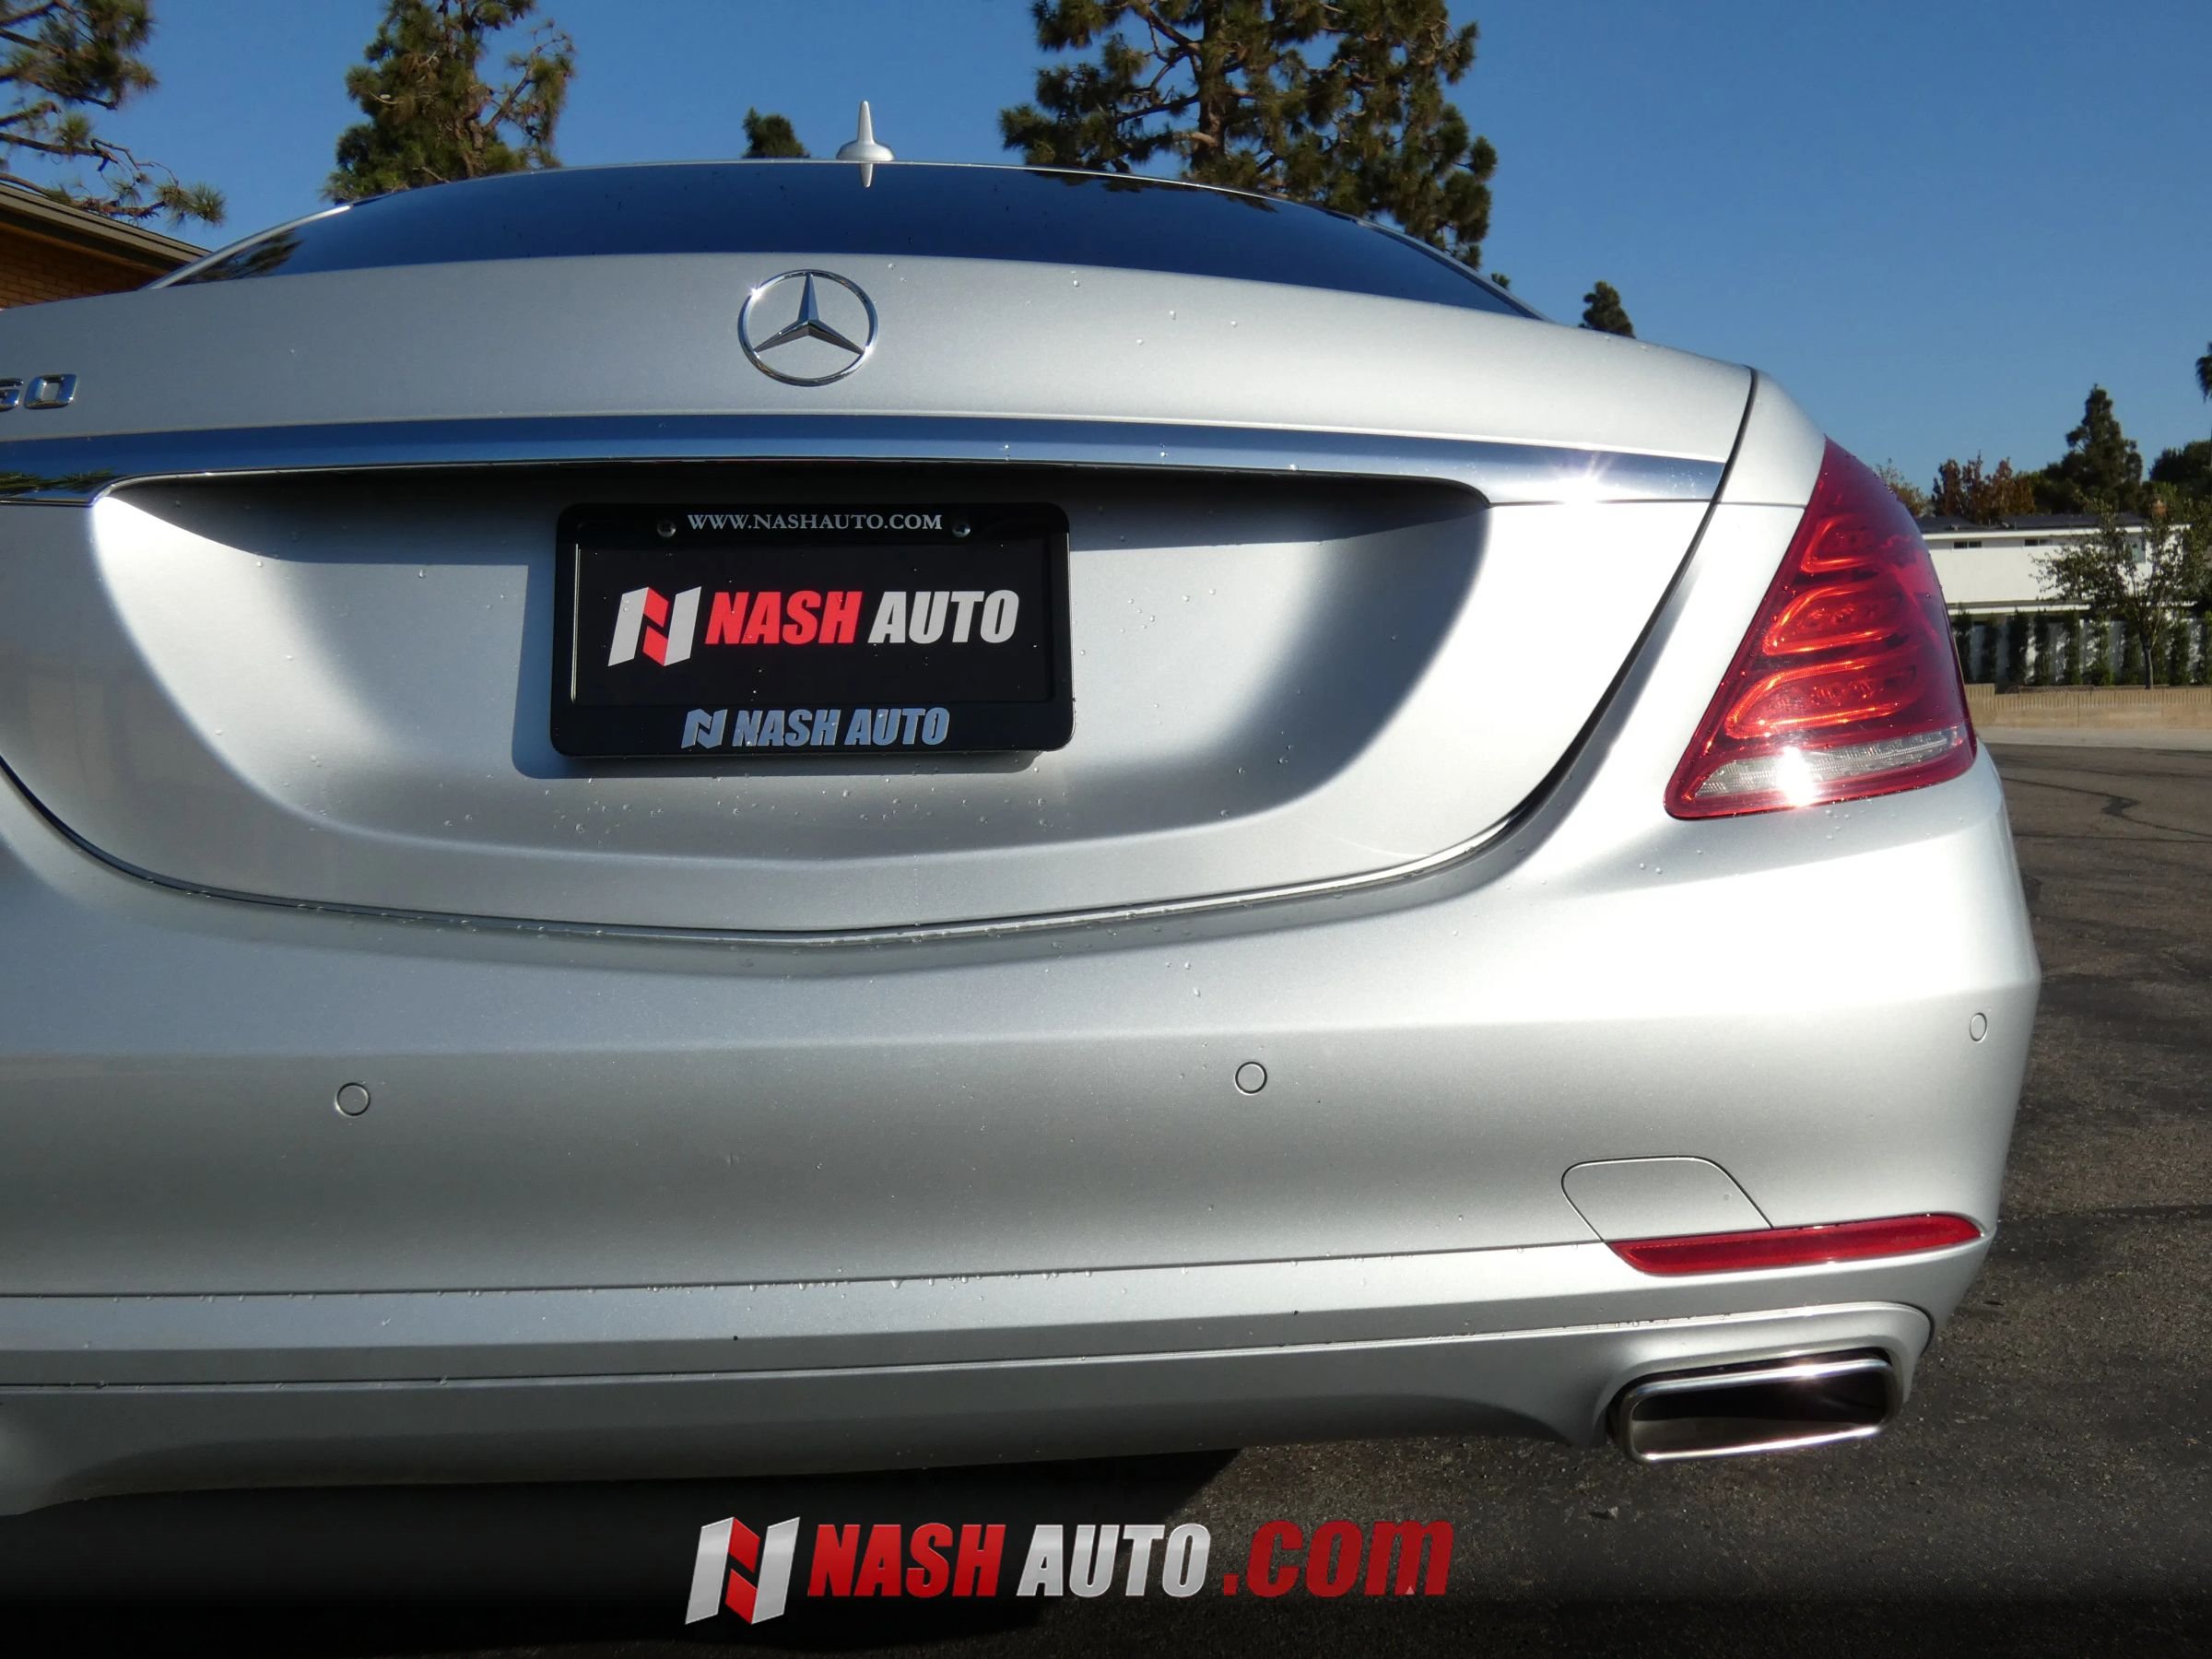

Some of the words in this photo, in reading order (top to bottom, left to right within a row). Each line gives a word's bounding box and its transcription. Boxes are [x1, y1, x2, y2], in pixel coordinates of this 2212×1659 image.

[688, 513, 943, 530] WWW.NASHAUTO.COM
[705, 590, 863, 644] NASH
[868, 590, 1019, 643] AUTO
[732, 709, 840, 747] NASH
[843, 707, 950, 746] AUTO
